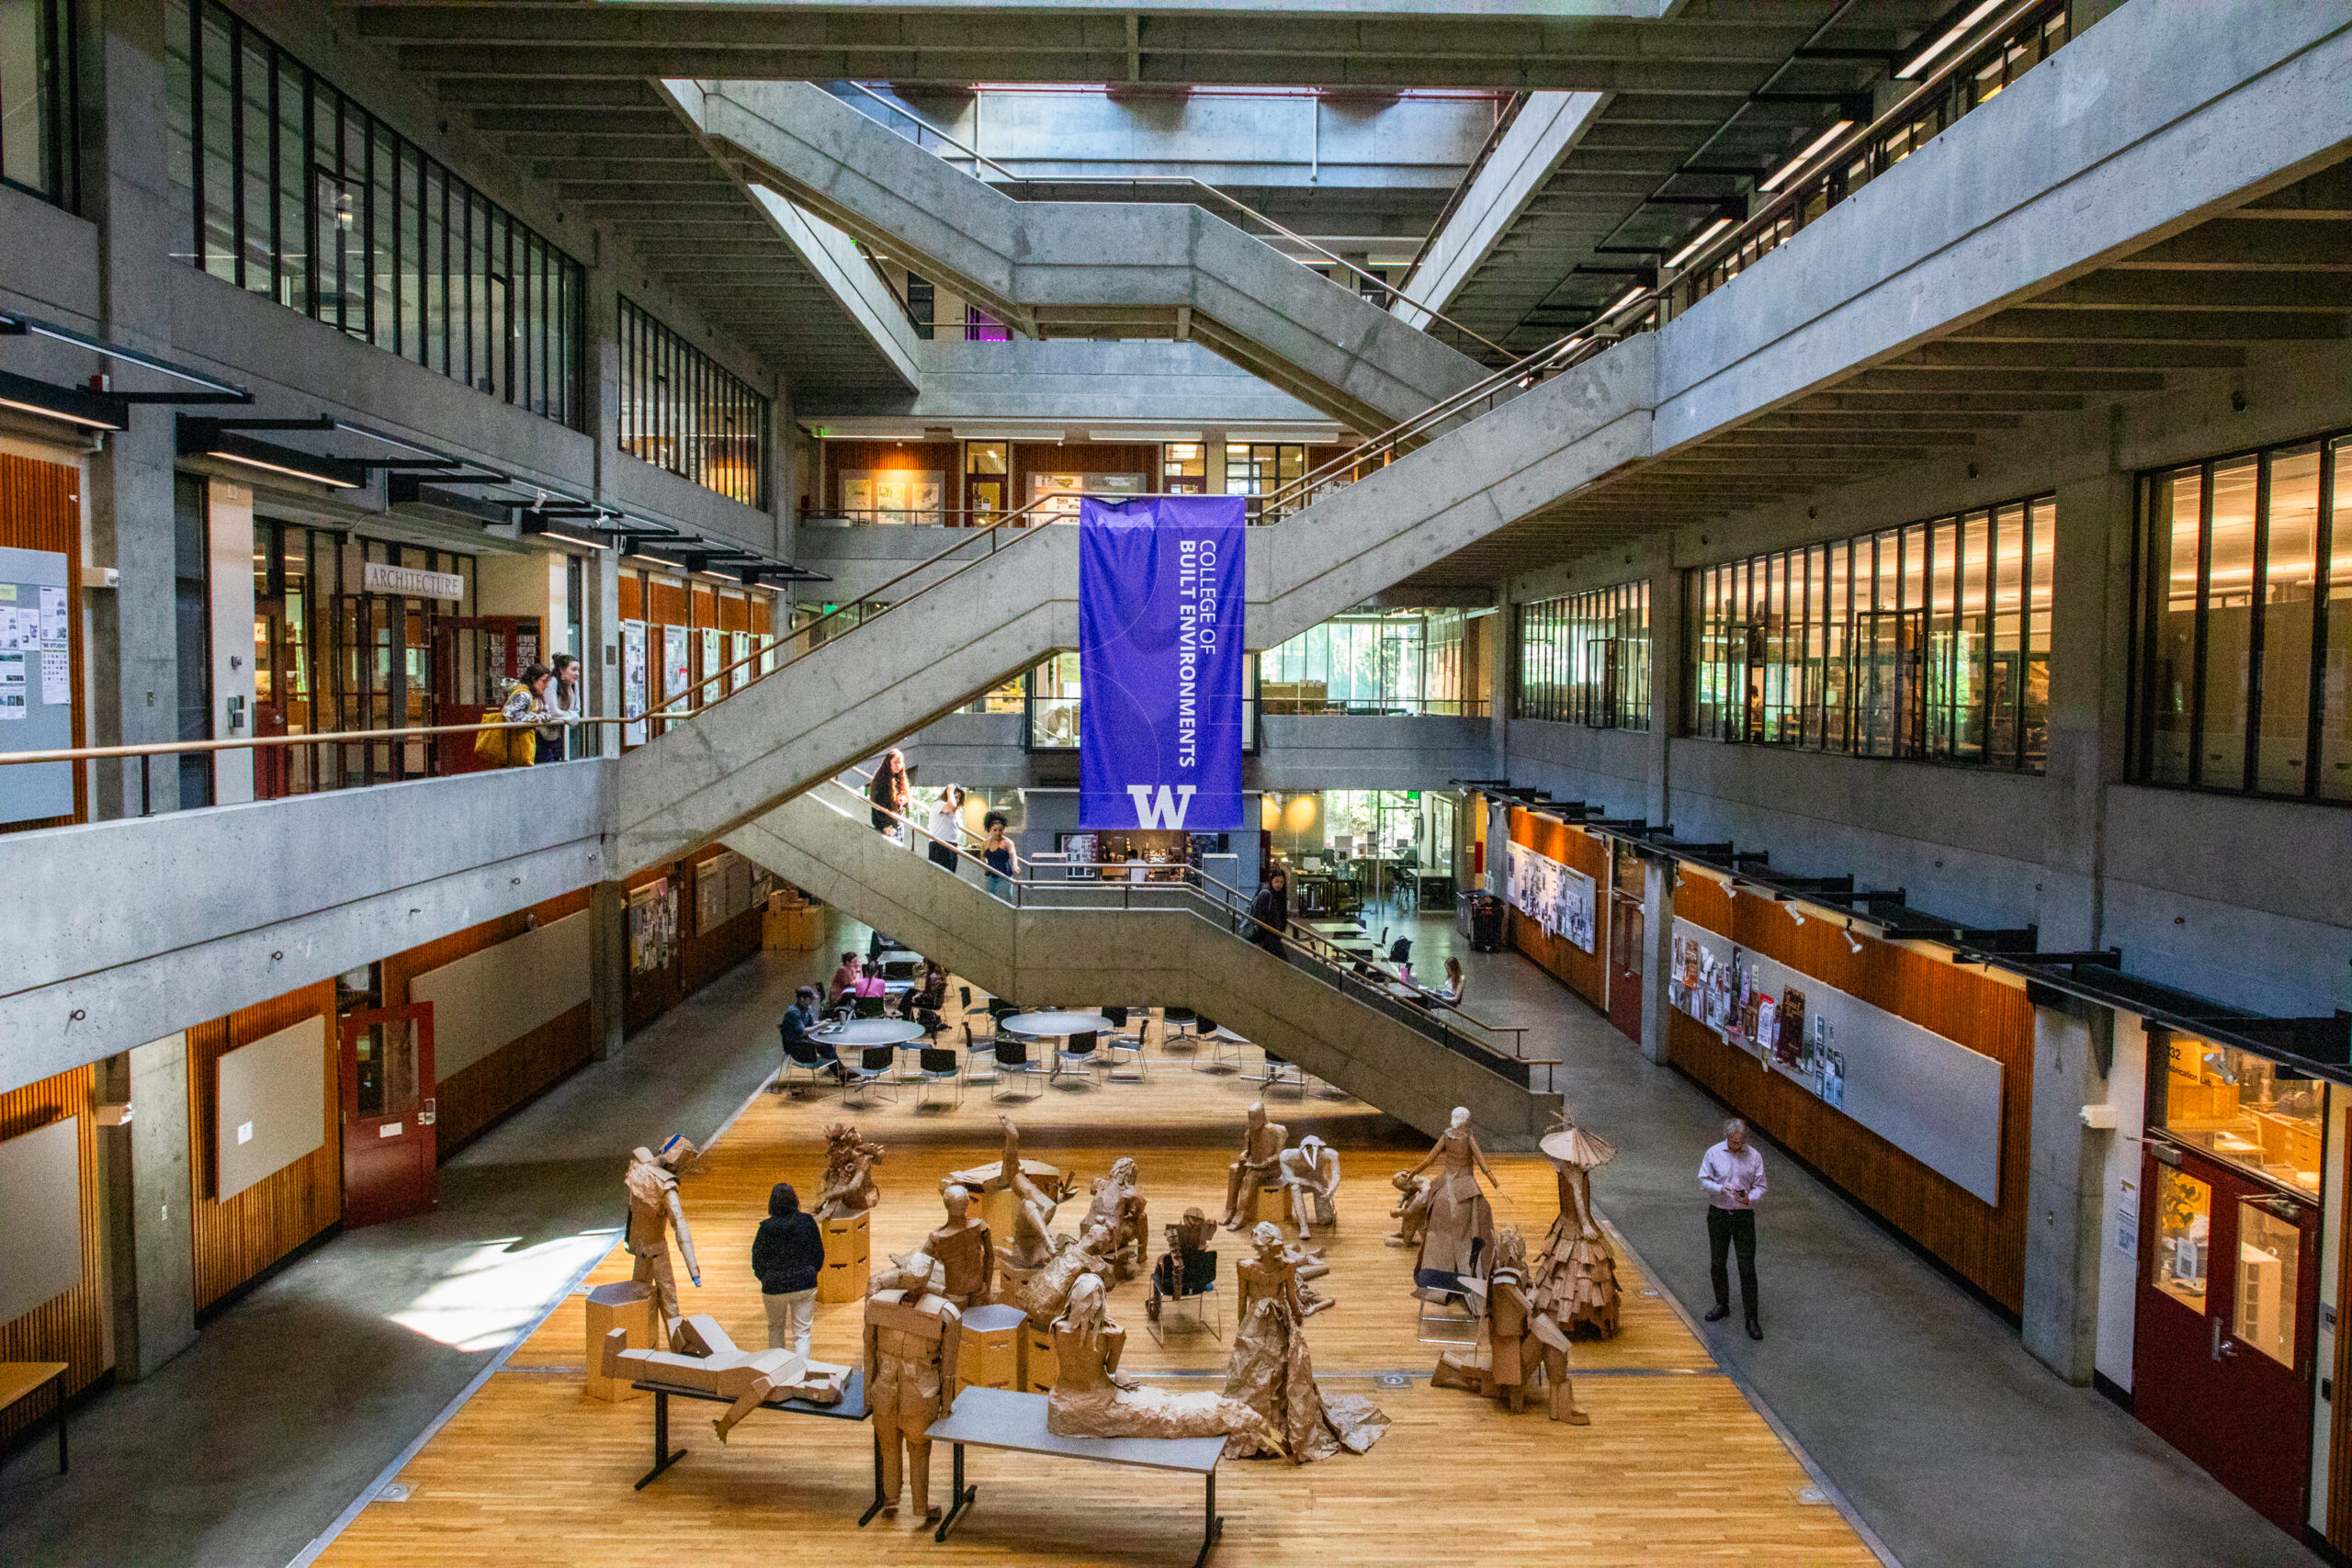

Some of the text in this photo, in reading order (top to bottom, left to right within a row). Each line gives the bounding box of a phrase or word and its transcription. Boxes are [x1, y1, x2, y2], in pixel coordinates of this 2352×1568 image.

[371, 567, 459, 596] ARCHITECTURE
[1200, 540, 1216, 655] COLLEGE OF
[1179, 540, 1196, 767] BUILT ENVIRONMENTS
[1126, 784, 1197, 830] W
[2167, 1046, 2181, 1061] 32
